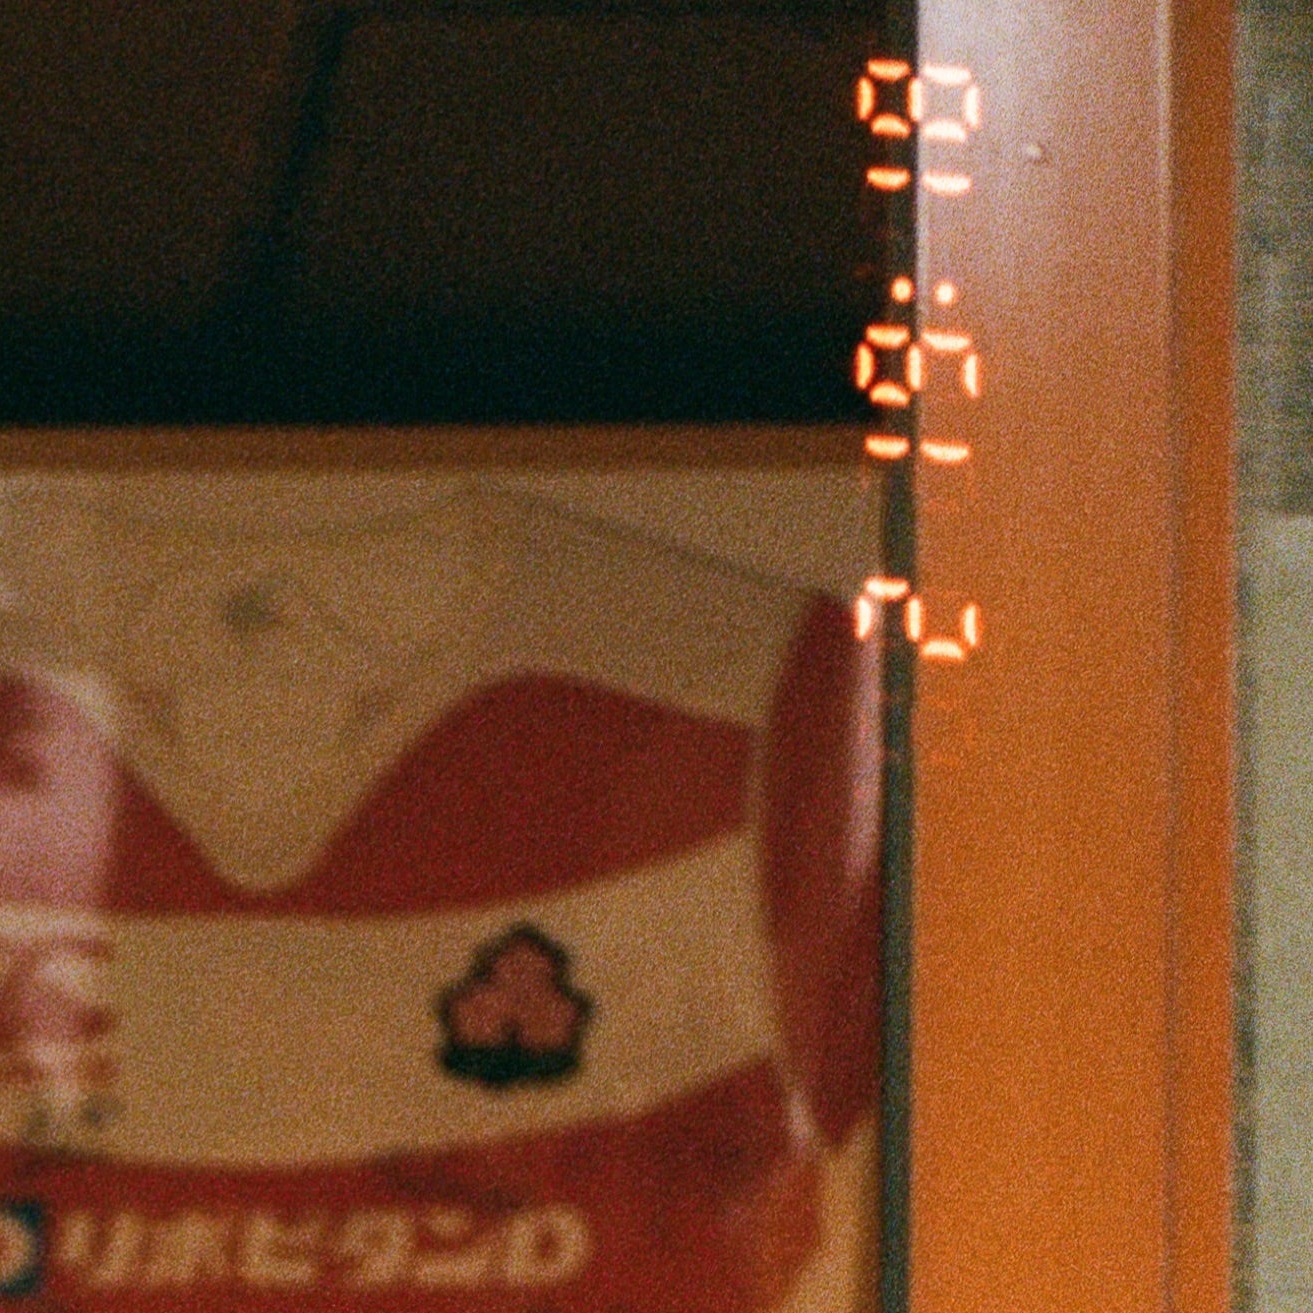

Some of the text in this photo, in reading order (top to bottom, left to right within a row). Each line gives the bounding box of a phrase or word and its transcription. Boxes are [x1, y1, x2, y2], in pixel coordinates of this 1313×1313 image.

[55, 1203, 590, 1290] リポビタンD
